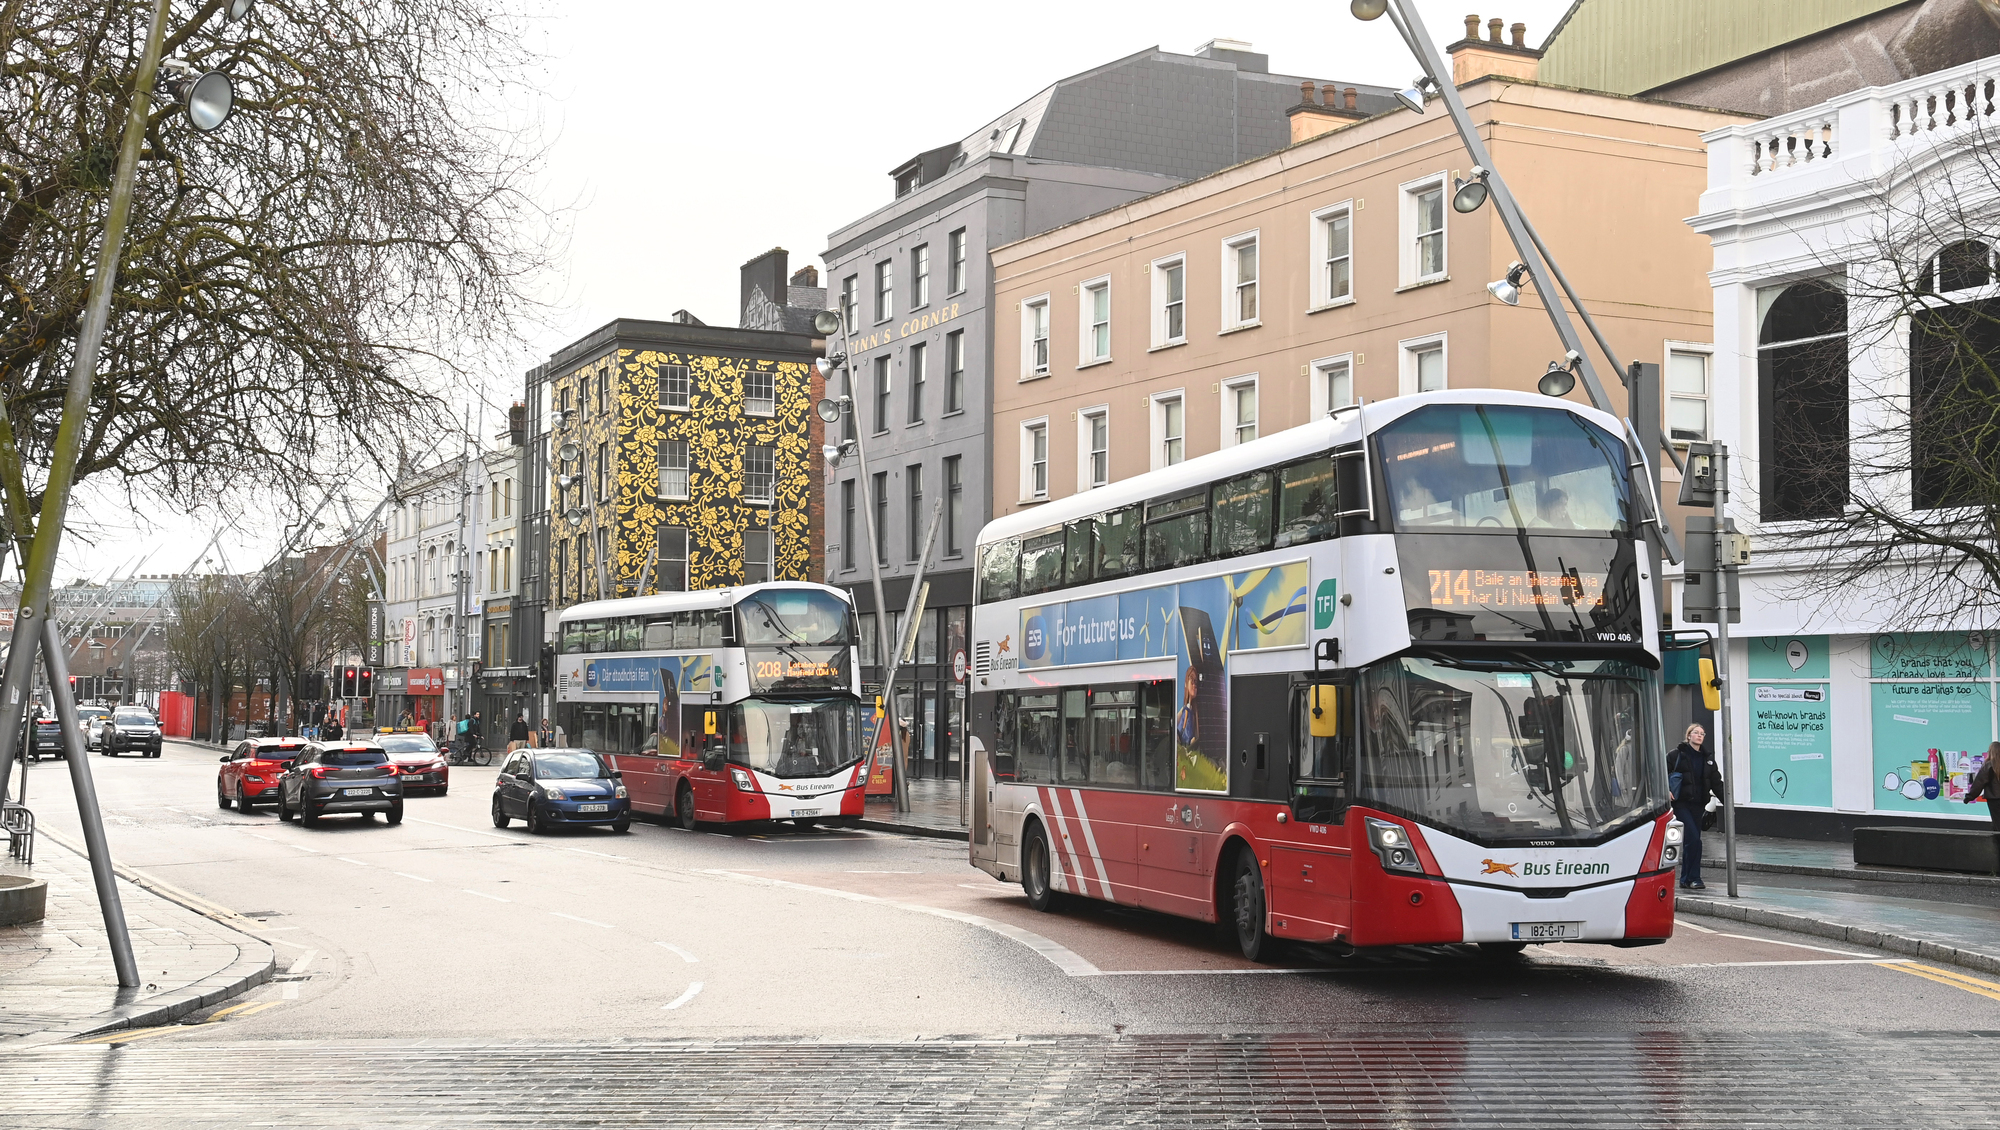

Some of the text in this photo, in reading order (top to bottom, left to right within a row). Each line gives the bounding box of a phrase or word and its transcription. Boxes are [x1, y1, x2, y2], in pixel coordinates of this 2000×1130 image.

[901, 303, 959, 337] CORNER
[1475, 570, 1504, 587] Baile
[1508, 574, 1522, 587] an
[1582, 575, 1598, 588] via
[1429, 570, 1470, 605] 214
[1317, 595, 1334, 614] TFI
[1056, 617, 1135, 647] For future us
[1597, 632, 1631, 642] VWD 406
[990, 658, 999, 671] Bus
[1901, 657, 1971, 668] Brands that you
[602, 668, 611, 682] Dár
[638, 667, 649, 682] féin
[757, 661, 781, 678] 208
[1891, 669, 1924, 678] already
[1927, 669, 1945, 678] love
[1956, 669, 1972, 678] and
[1892, 685, 1971, 695] future darlings too
[1757, 710, 1826, 720] Well-known brands
[1757, 720, 1824, 732] at fixed low prices
[1309, 825, 1319, 834] VWD
[1523, 858, 1610, 876] Bus Éireann
[1531, 925, 1565, 937] 182-G-17
